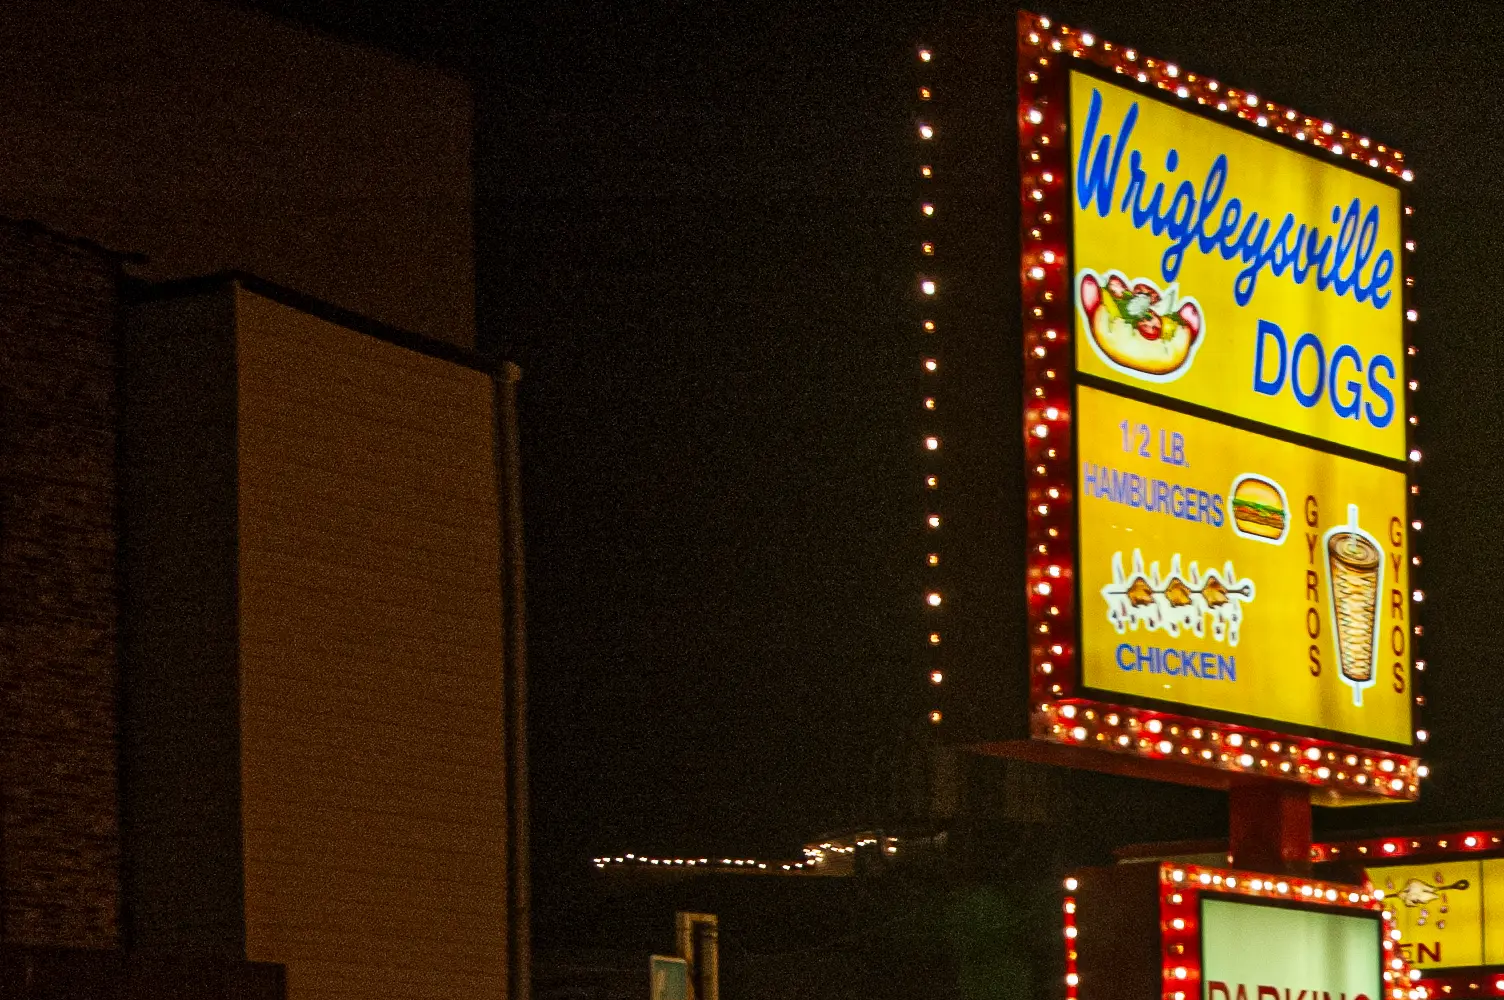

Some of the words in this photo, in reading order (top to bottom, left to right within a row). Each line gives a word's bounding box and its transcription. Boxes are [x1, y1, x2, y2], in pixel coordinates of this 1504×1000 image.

[1077, 88, 1396, 311] Wrigleysville
[1252, 319, 1396, 429] DOGS
[1083, 462, 1224, 529] HAMBURGERS
[1304, 494, 1323, 679] GYROS
[1388, 516, 1406, 695] GYROS
[1115, 643, 1237, 682] CHICKEN
[1399, 941, 1442, 965] EN
